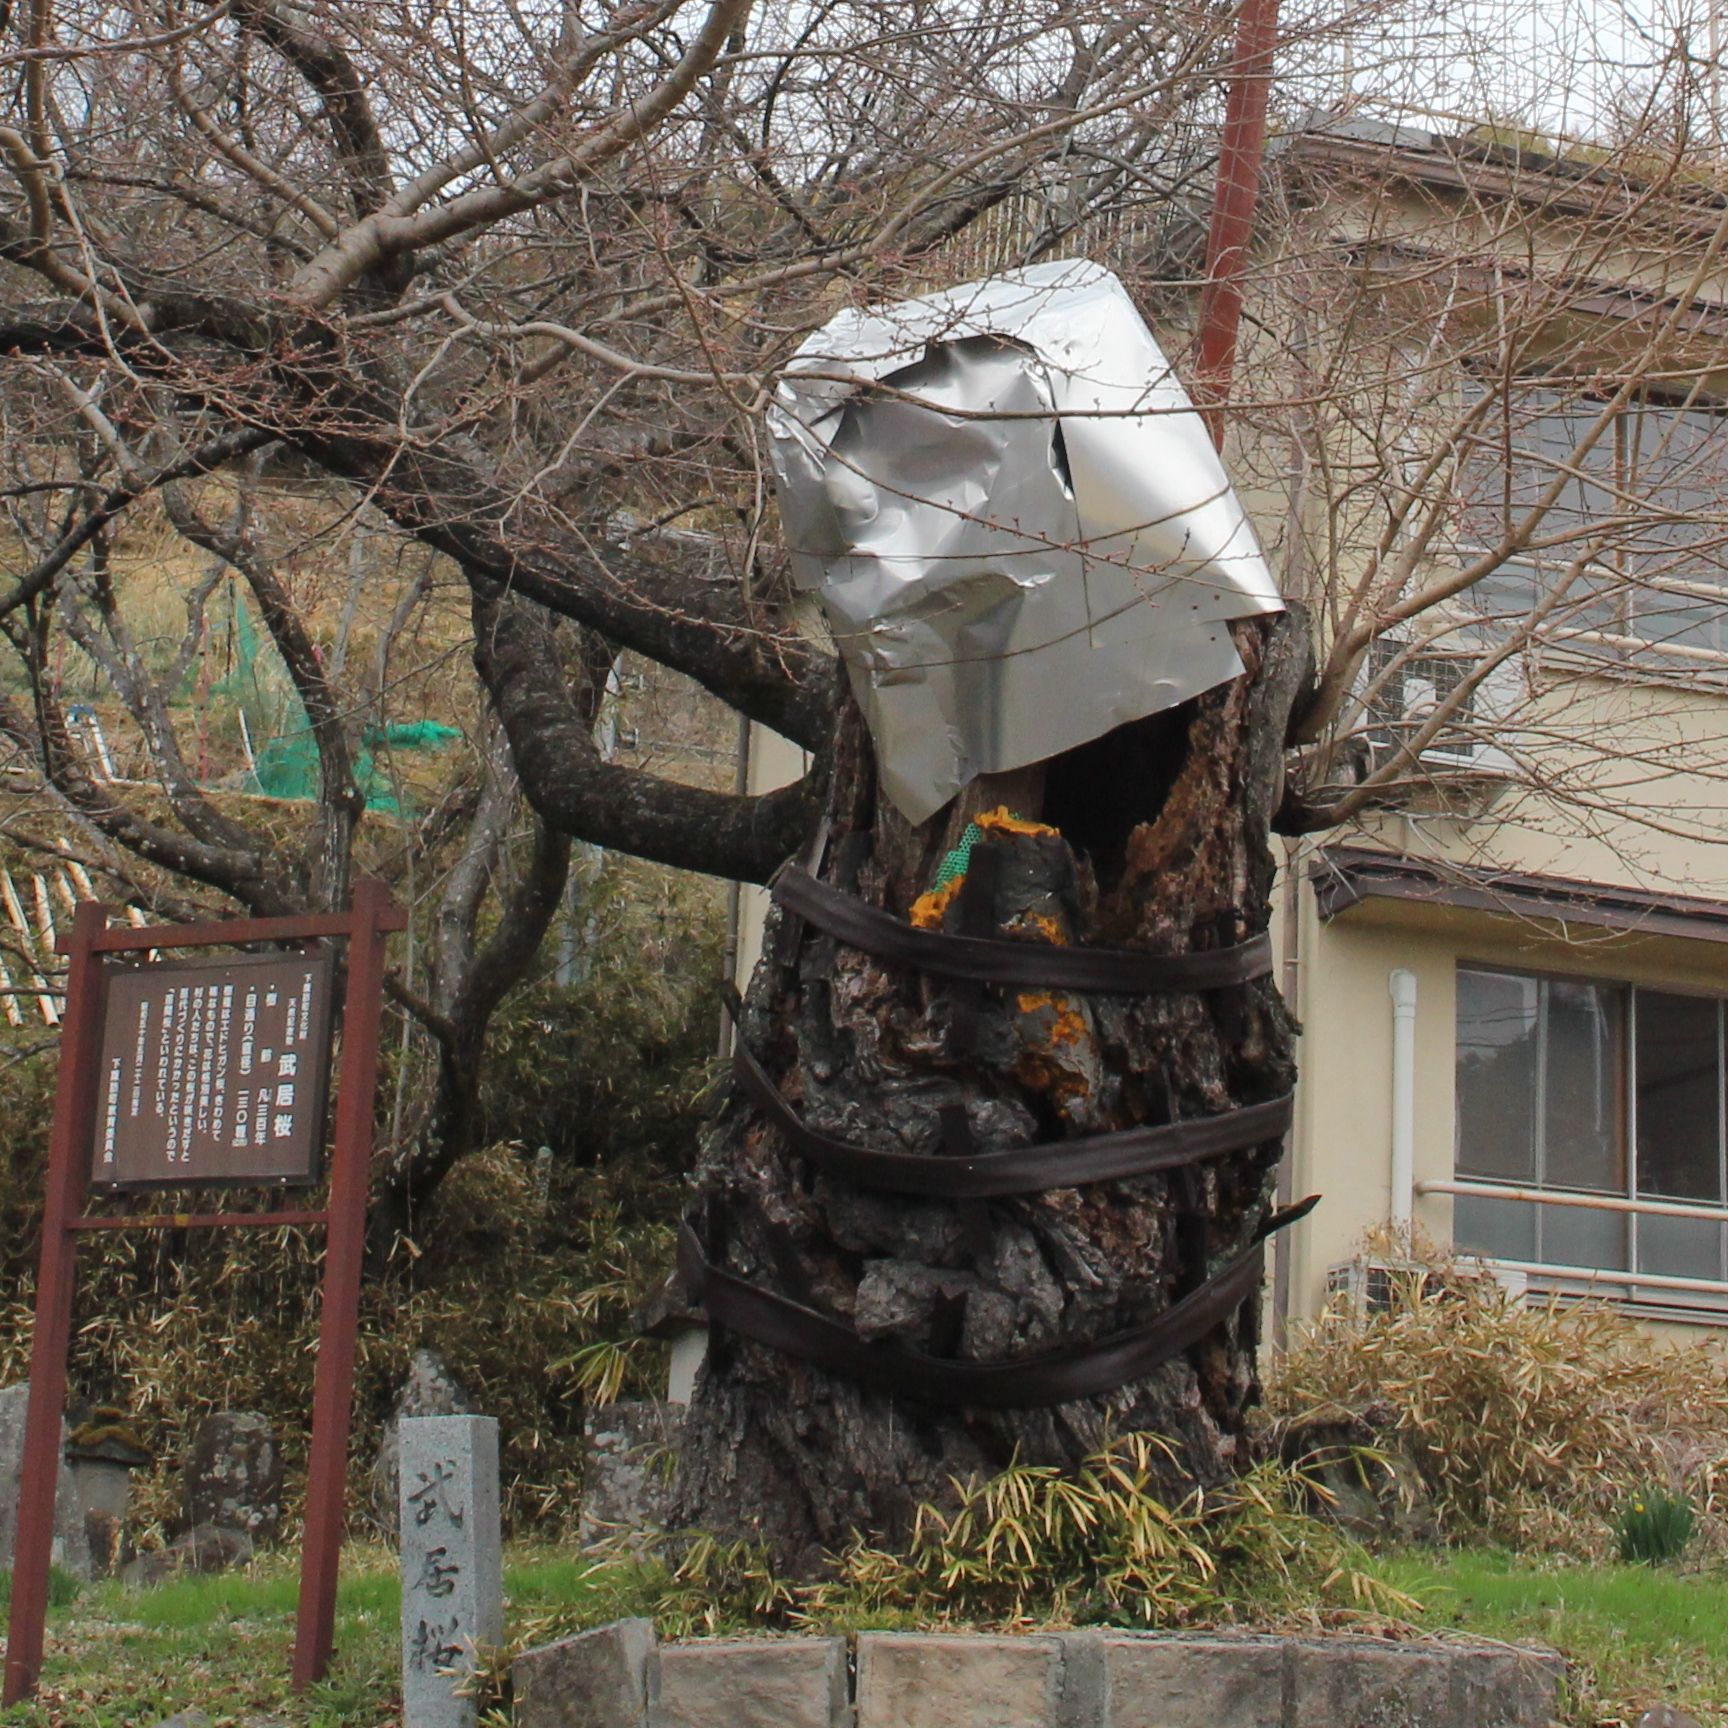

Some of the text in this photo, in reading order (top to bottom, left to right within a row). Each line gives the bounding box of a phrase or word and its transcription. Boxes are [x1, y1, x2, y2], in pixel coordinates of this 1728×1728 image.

[255, 1089, 268, 1145] 凡三百年
[274, 1054, 296, 1137] 武居桜
[407, 1458, 464, 1668] 武居桜
